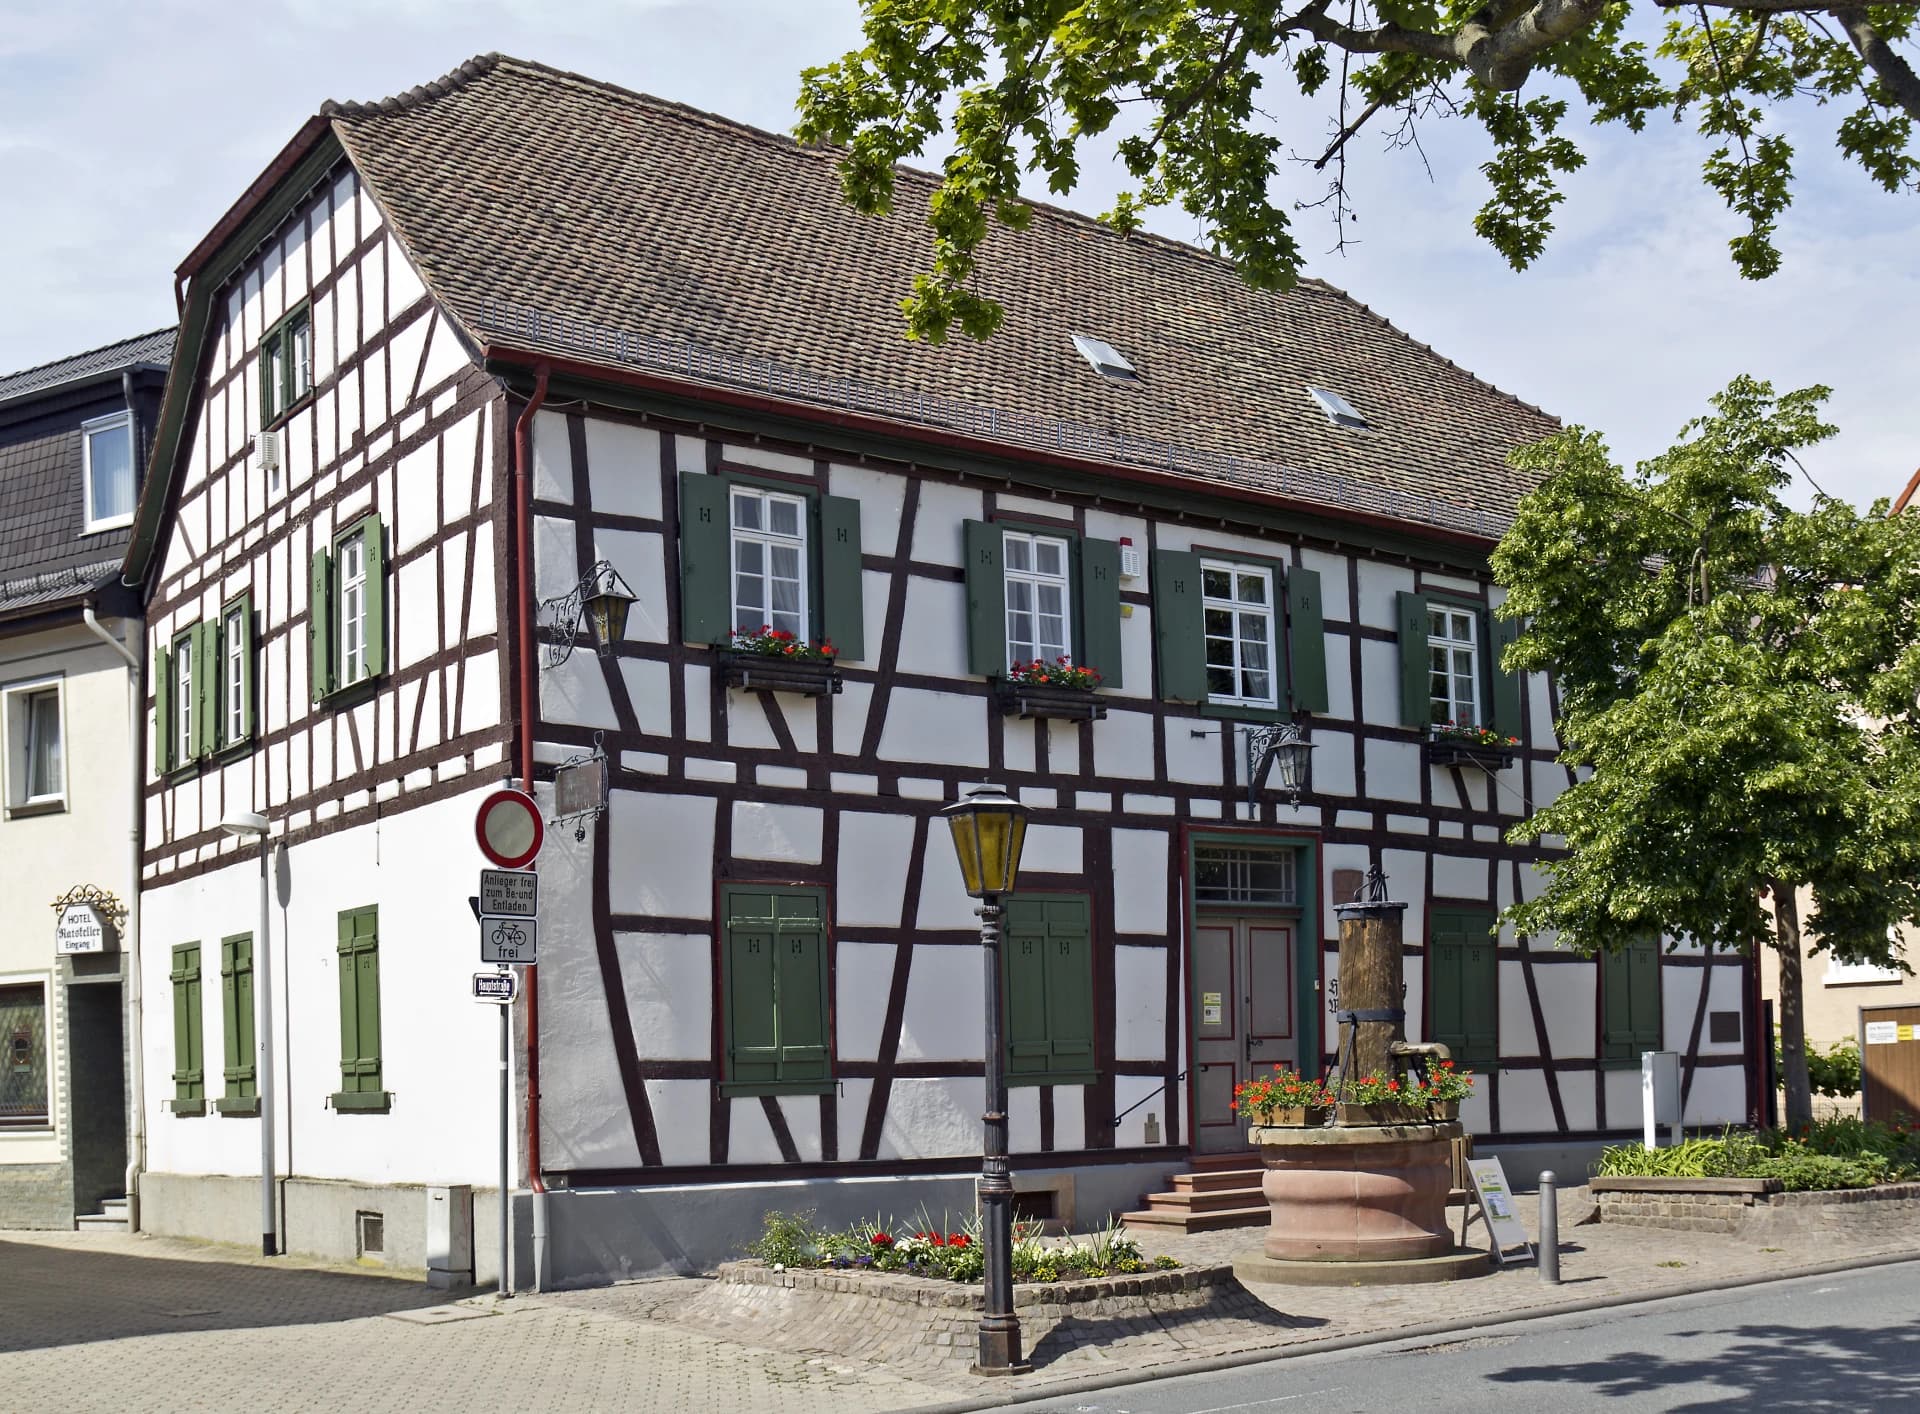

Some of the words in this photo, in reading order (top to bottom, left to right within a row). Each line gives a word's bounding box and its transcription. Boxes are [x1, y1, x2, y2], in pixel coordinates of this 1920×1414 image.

[484, 874, 518, 887] Anlieger
[521, 877, 535, 888] frei
[486, 889, 503, 898] zum
[492, 899, 527, 912] Entladen
[68, 914, 92, 924] HOTEL
[65, 940, 90, 950] Eingang
[498, 945, 518, 959] frei
[478, 979, 511, 992] Hauptstraße
